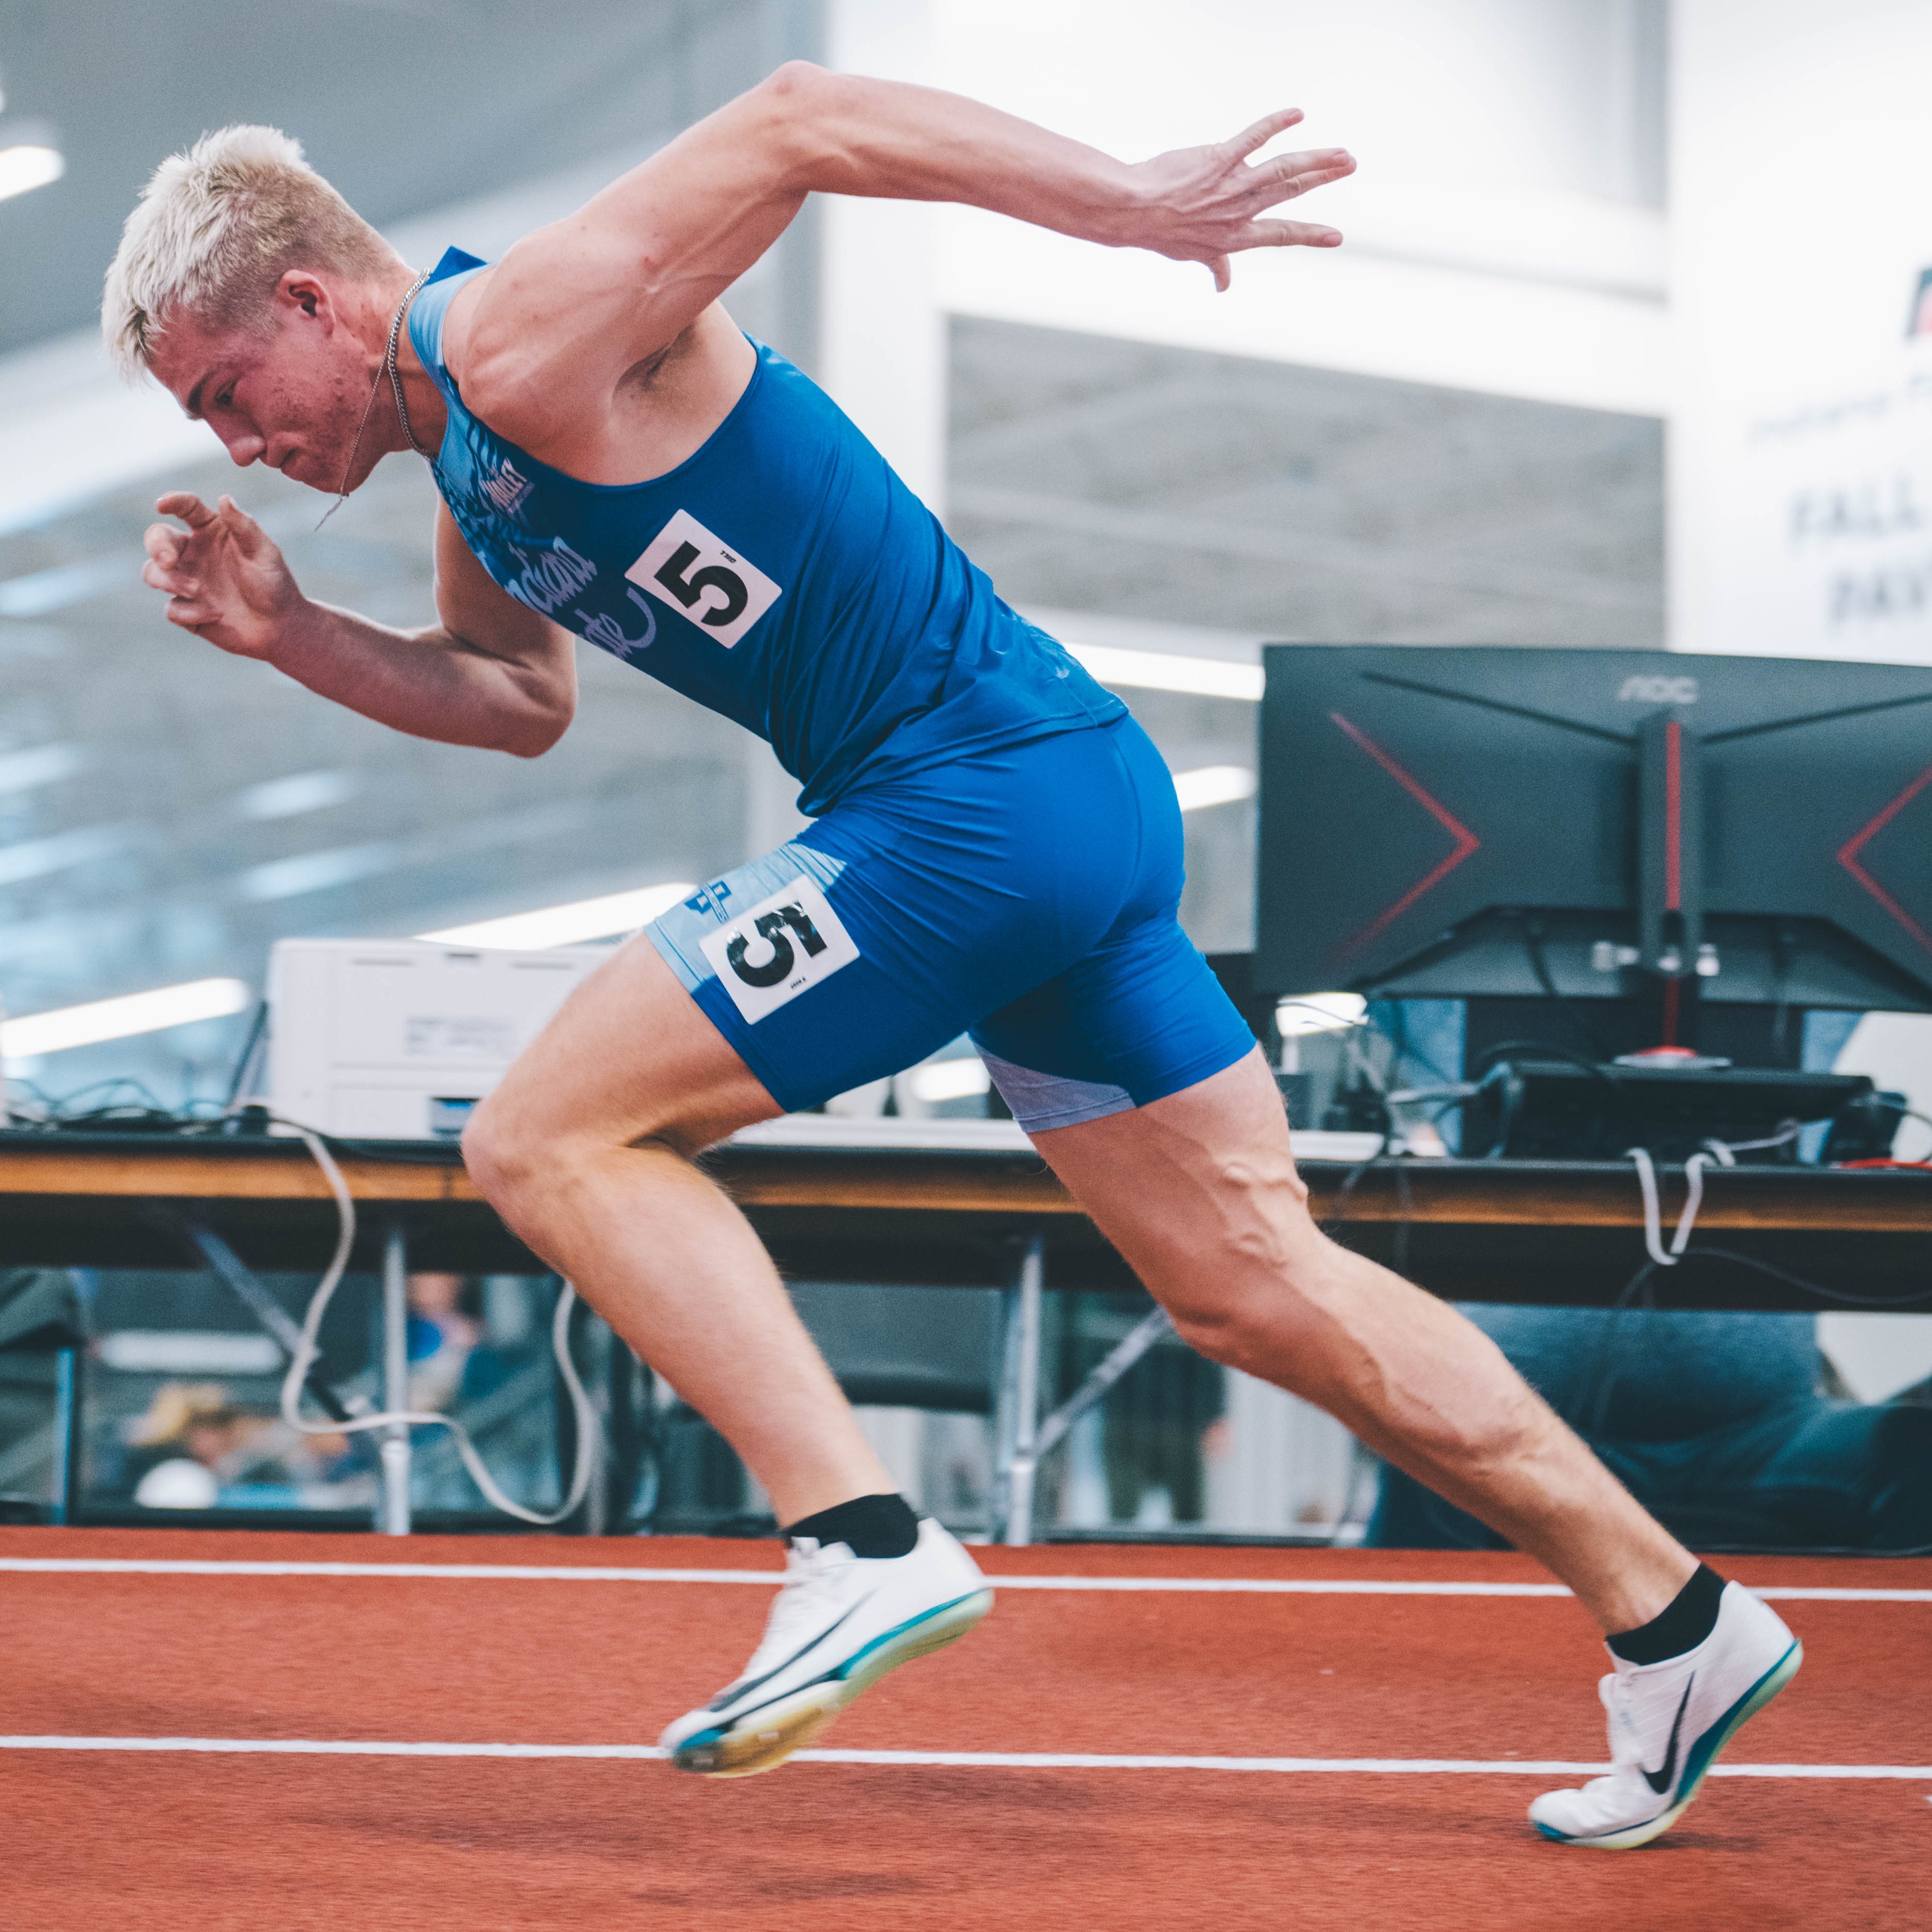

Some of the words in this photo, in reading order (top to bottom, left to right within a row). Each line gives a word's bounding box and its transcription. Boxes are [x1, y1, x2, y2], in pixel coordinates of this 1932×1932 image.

[653, 540, 748, 627] 5
[1619, 676, 1698, 704] AOC
[726, 900, 827, 987] 5
